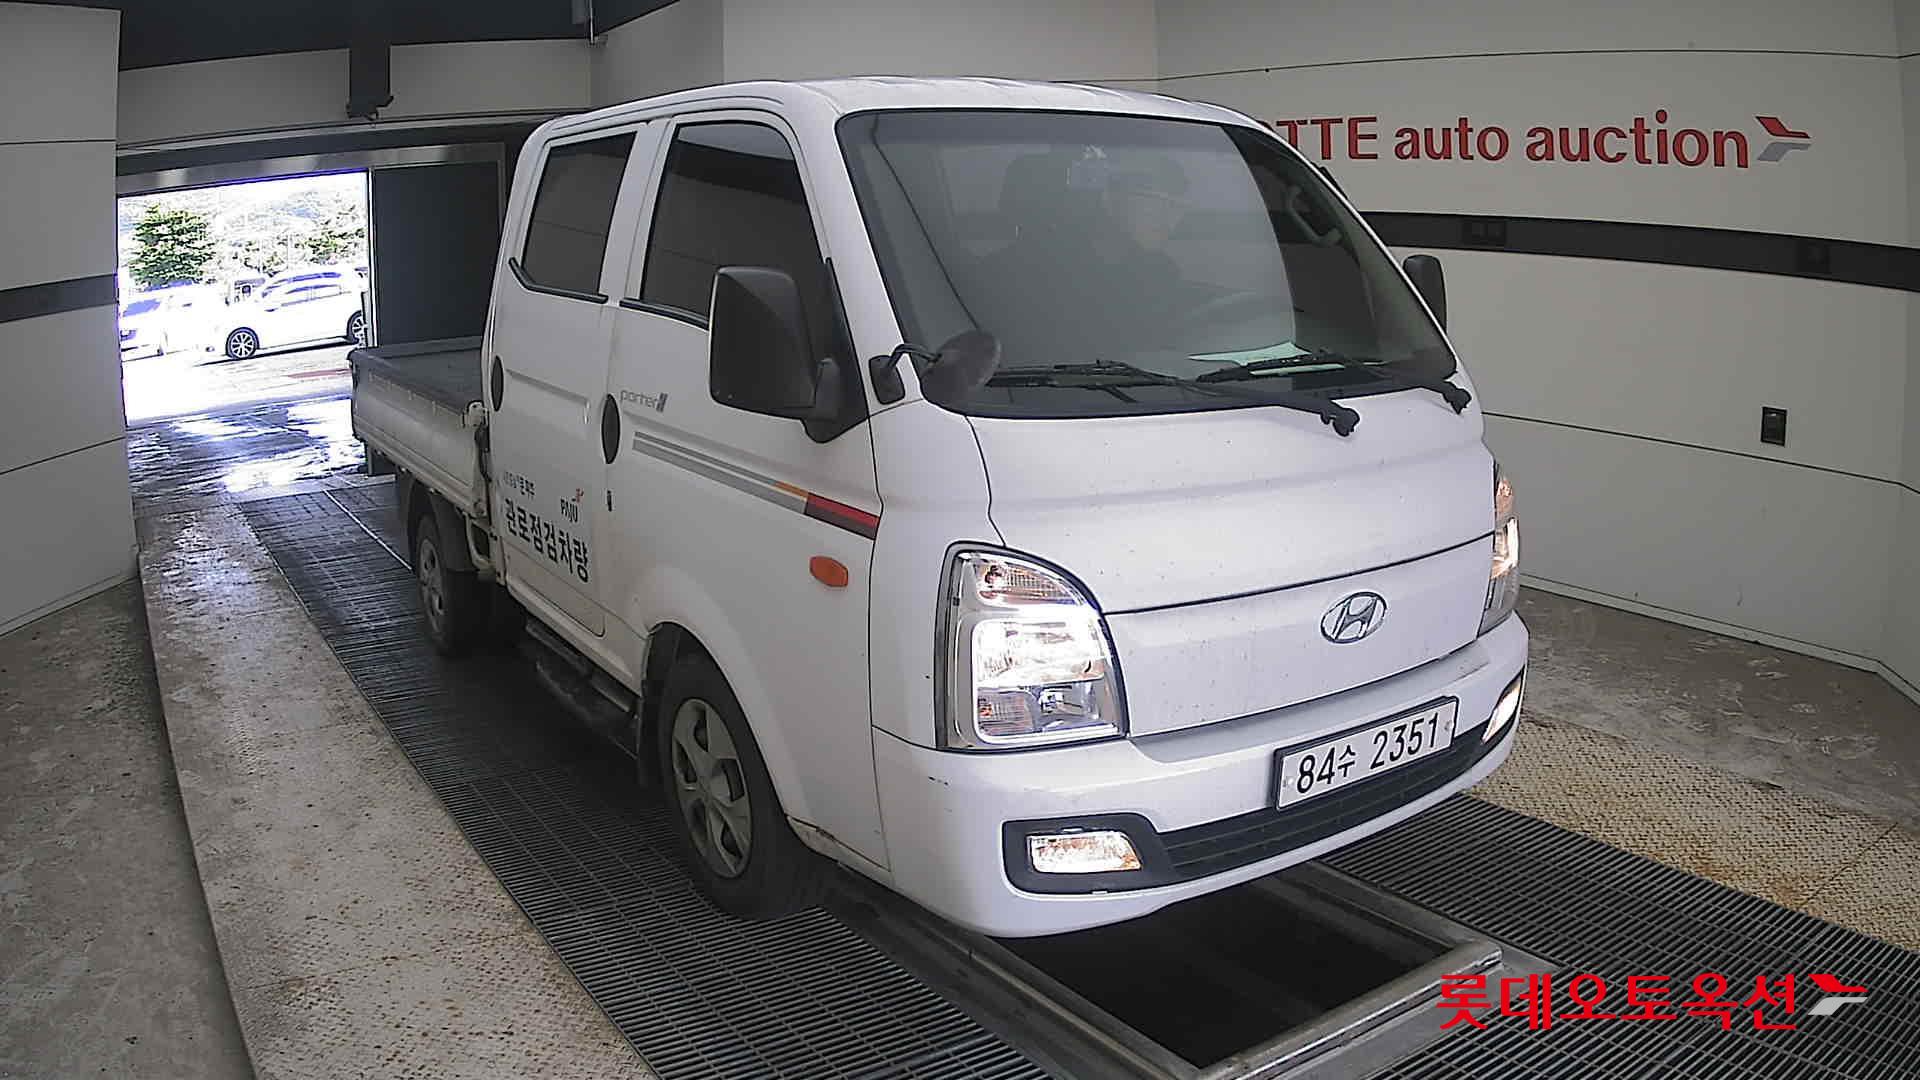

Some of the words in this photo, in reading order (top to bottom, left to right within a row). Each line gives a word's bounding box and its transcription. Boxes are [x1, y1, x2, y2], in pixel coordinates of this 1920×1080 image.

[1393, 117, 1509, 161] auto
[1525, 109, 1750, 169] auction
[560, 497, 579, 523] PAJU
[1296, 744, 1356, 794] 84수
[1370, 711, 1440, 770] 2351
